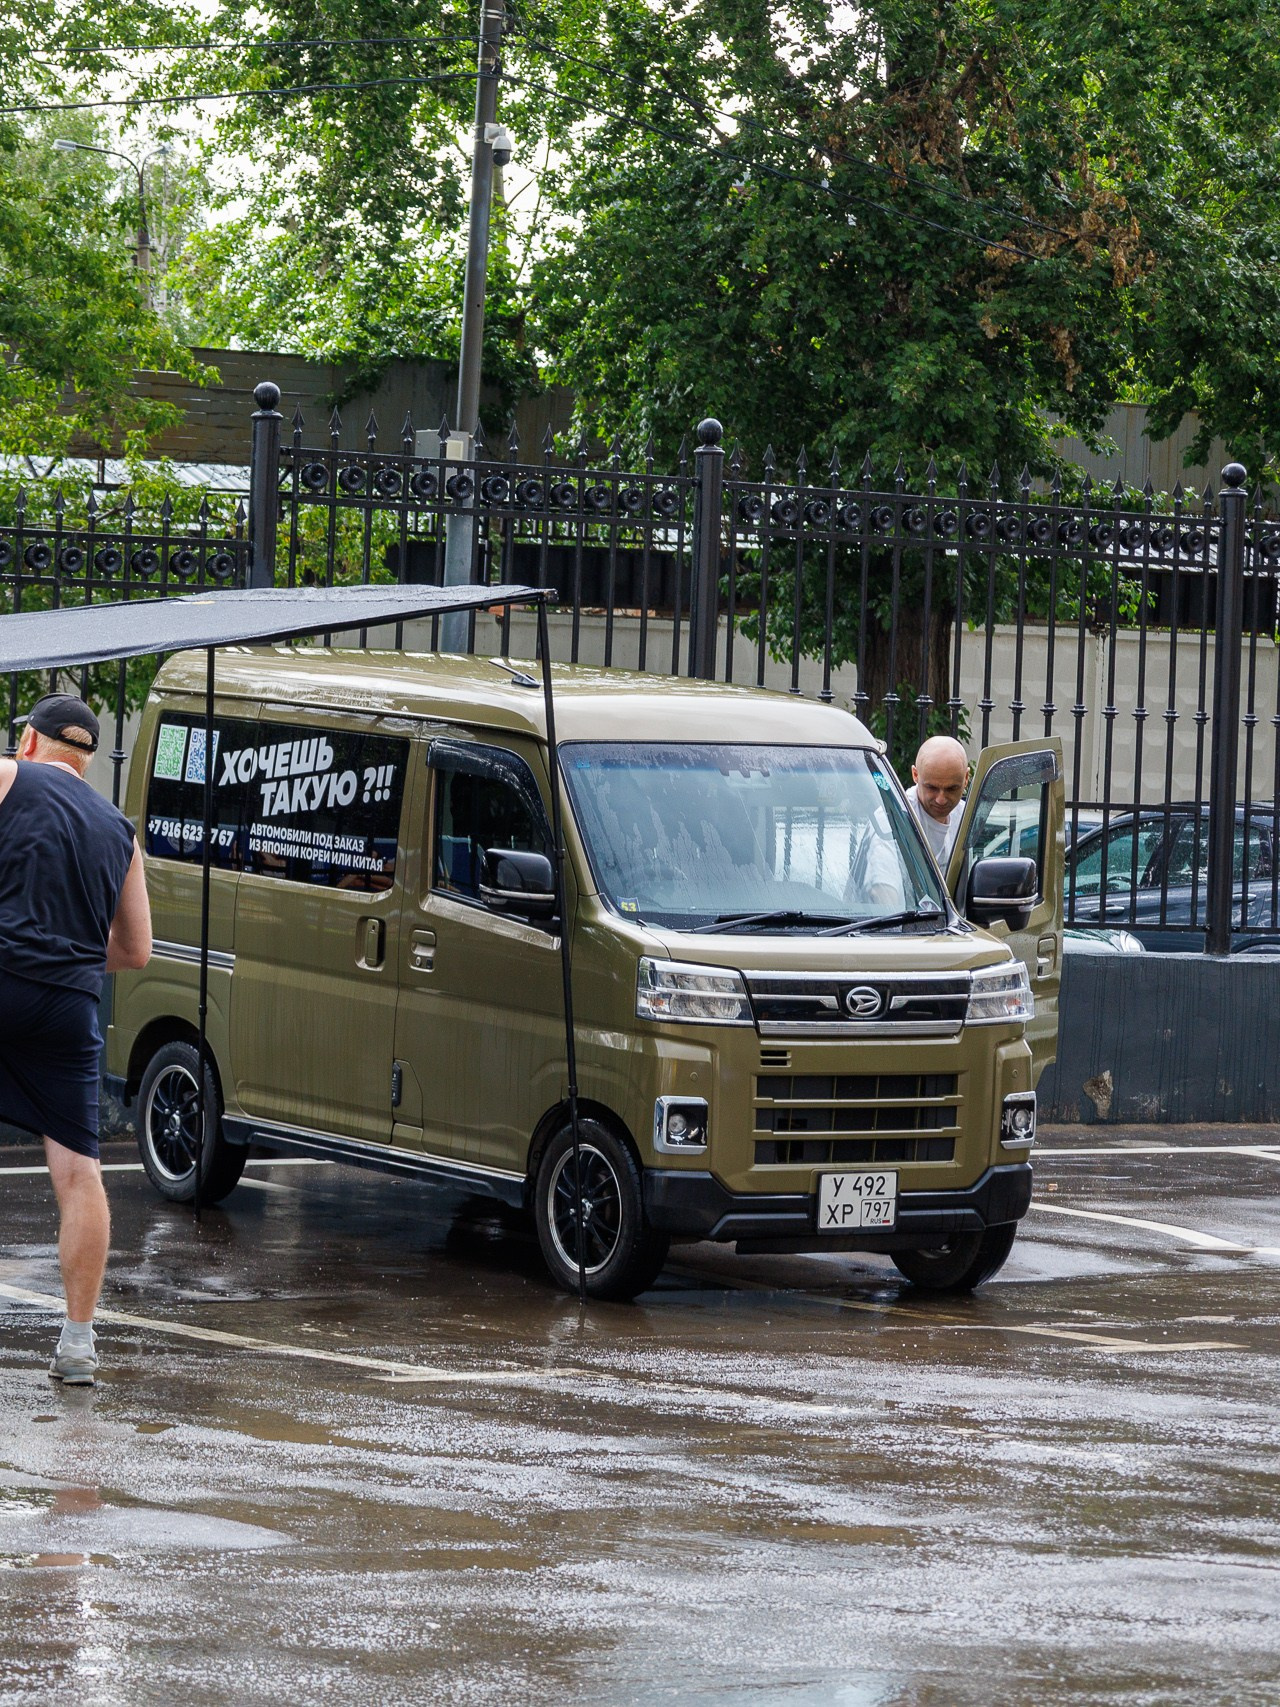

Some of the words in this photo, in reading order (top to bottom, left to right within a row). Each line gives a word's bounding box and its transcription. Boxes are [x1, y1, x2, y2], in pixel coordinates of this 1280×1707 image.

[218, 736, 334, 786] ХОЧЕШЬ
[260, 770, 357, 817] ТАКУЮ
[362, 764, 395, 804] ?!!
[148, 819, 161, 835] +7
[161, 820, 182, 839] 916
[182, 823, 203, 842] 623
[218, 829, 234, 847] 67
[249, 822, 312, 845] АВТОМОБИЛИ
[312, 832, 333, 850] ПОД
[333, 835, 365, 853] ЗАКАЗ
[249, 837, 261, 852] ИЗ
[261, 839, 300, 858] ЯПОНИИ
[300, 846, 331, 863] КОРЕИ
[331, 852, 352, 867] ИЛИ
[352, 855, 383, 872] КИТАЯ
[852, 1176, 886, 1196] 492
[826, 1203, 854, 1224] ХР
[864, 1201, 891, 1218] 797
